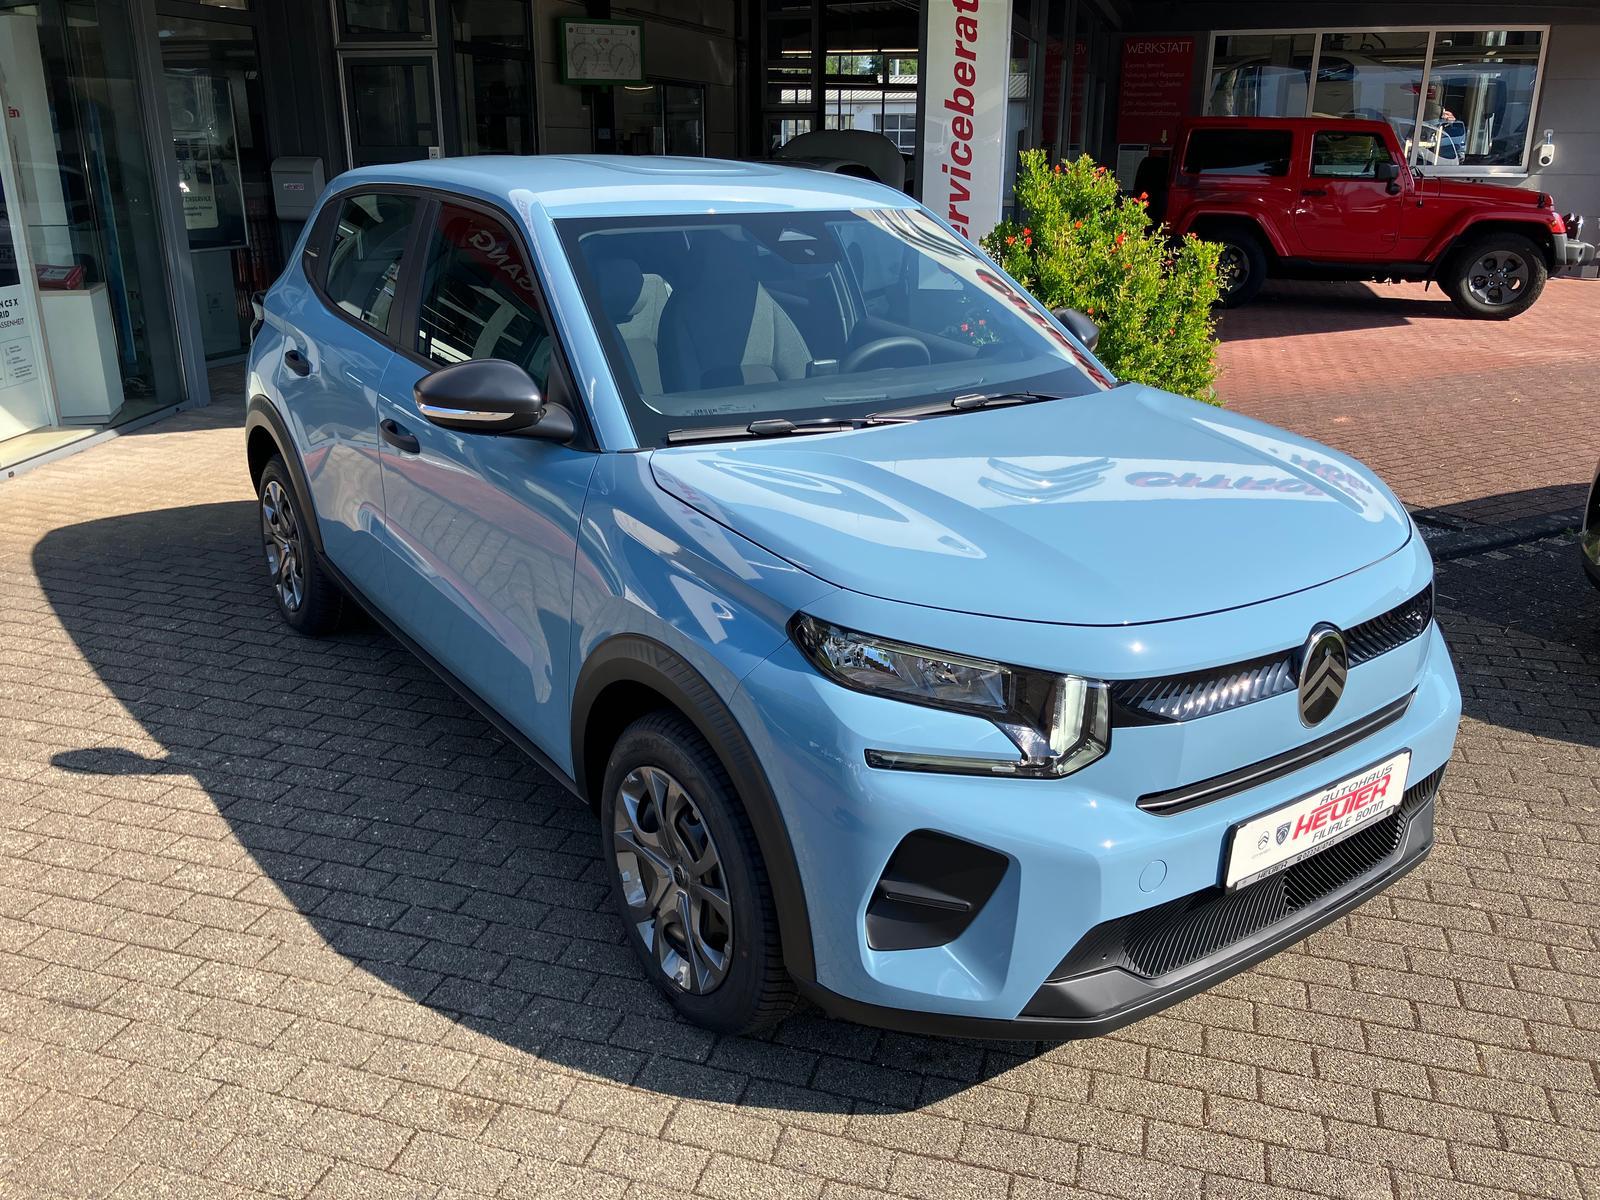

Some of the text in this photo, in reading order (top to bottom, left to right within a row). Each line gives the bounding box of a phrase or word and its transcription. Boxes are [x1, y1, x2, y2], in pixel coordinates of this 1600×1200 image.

[1126, 41, 1193, 54] WERKSTATT
[1319, 763, 1394, 806] AUTOHAUS
[1292, 773, 1391, 841] HEUTER
[1312, 816, 1351, 844] FILIALE
